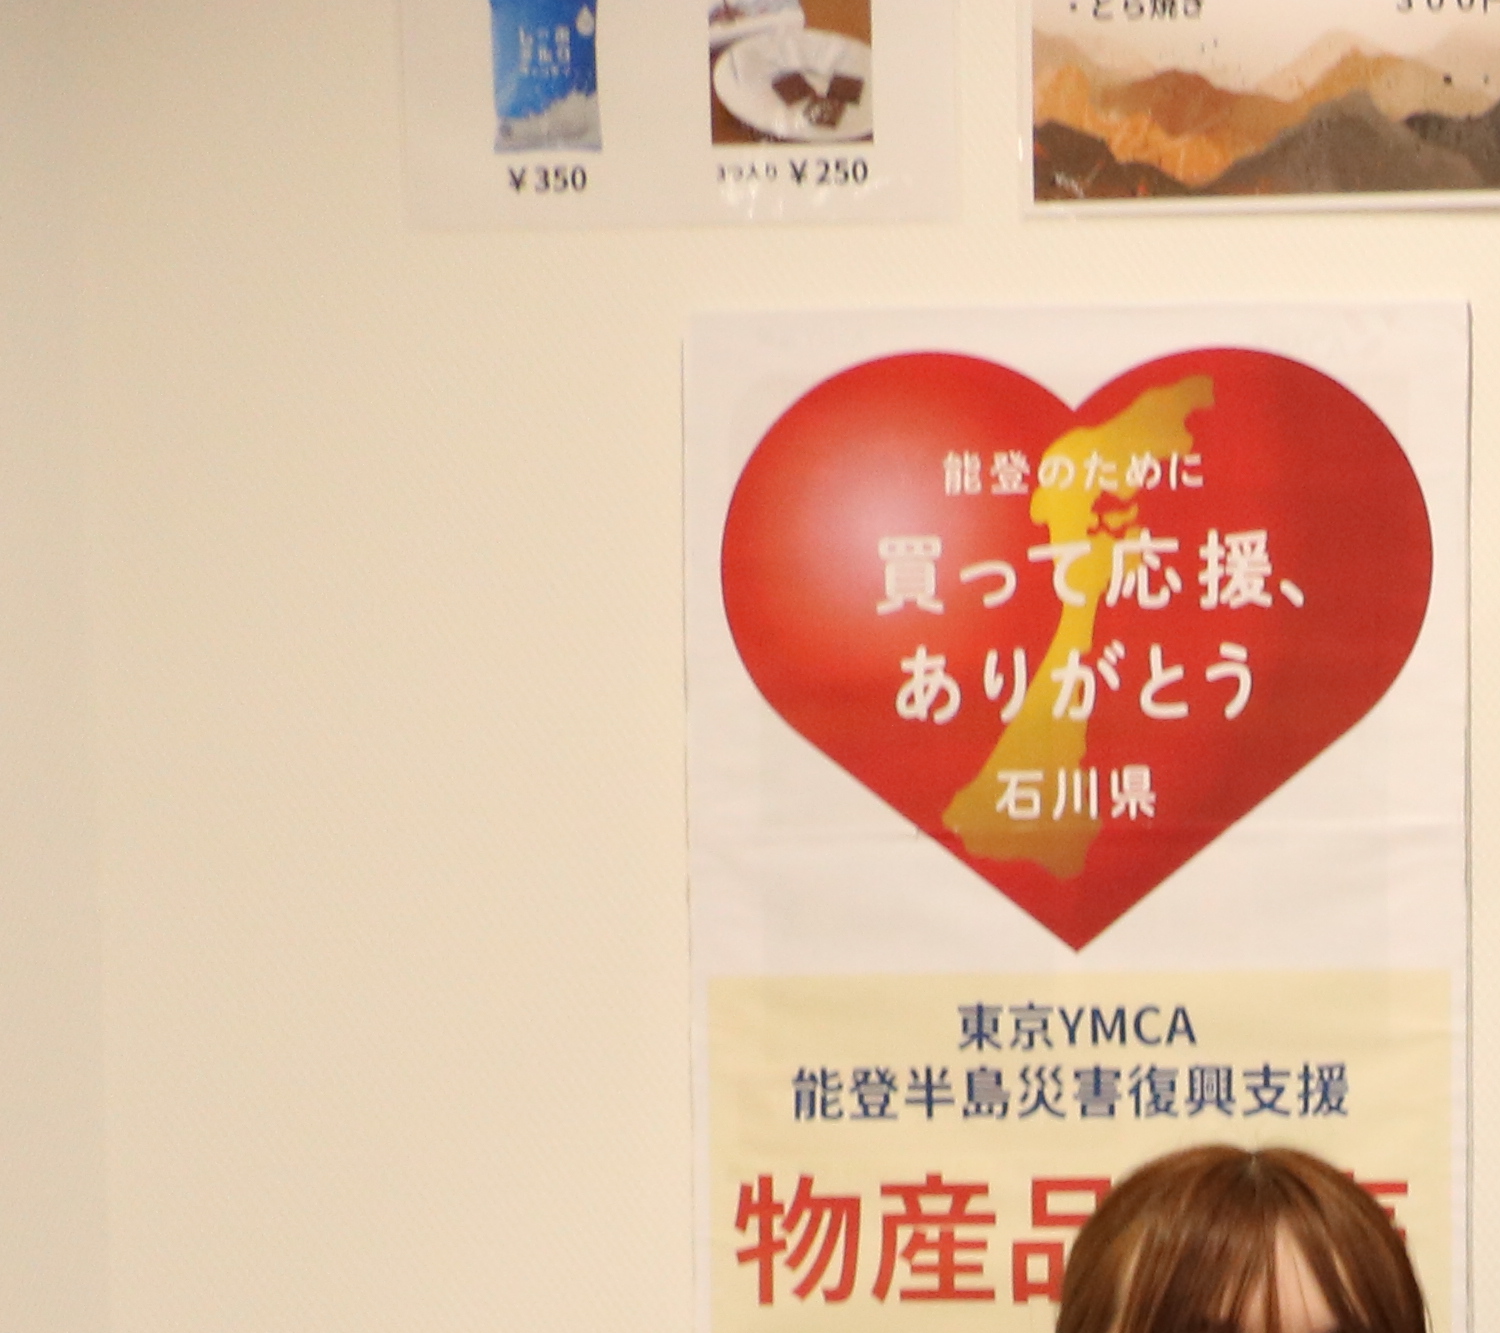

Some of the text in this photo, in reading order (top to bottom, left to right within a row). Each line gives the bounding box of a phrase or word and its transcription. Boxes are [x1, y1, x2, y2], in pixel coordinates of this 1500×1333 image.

[508, 165, 589, 194] ¥350
[942, 450, 1205, 497] 能登のために
[876, 528, 1306, 615] 買って応援、
[895, 641, 1254, 725] ありがとう
[995, 764, 1158, 821] 石川県
[956, 1000, 1199, 1053] 東京YMCA
[791, 1062, 1351, 1122] 能登半島災害復興支援
